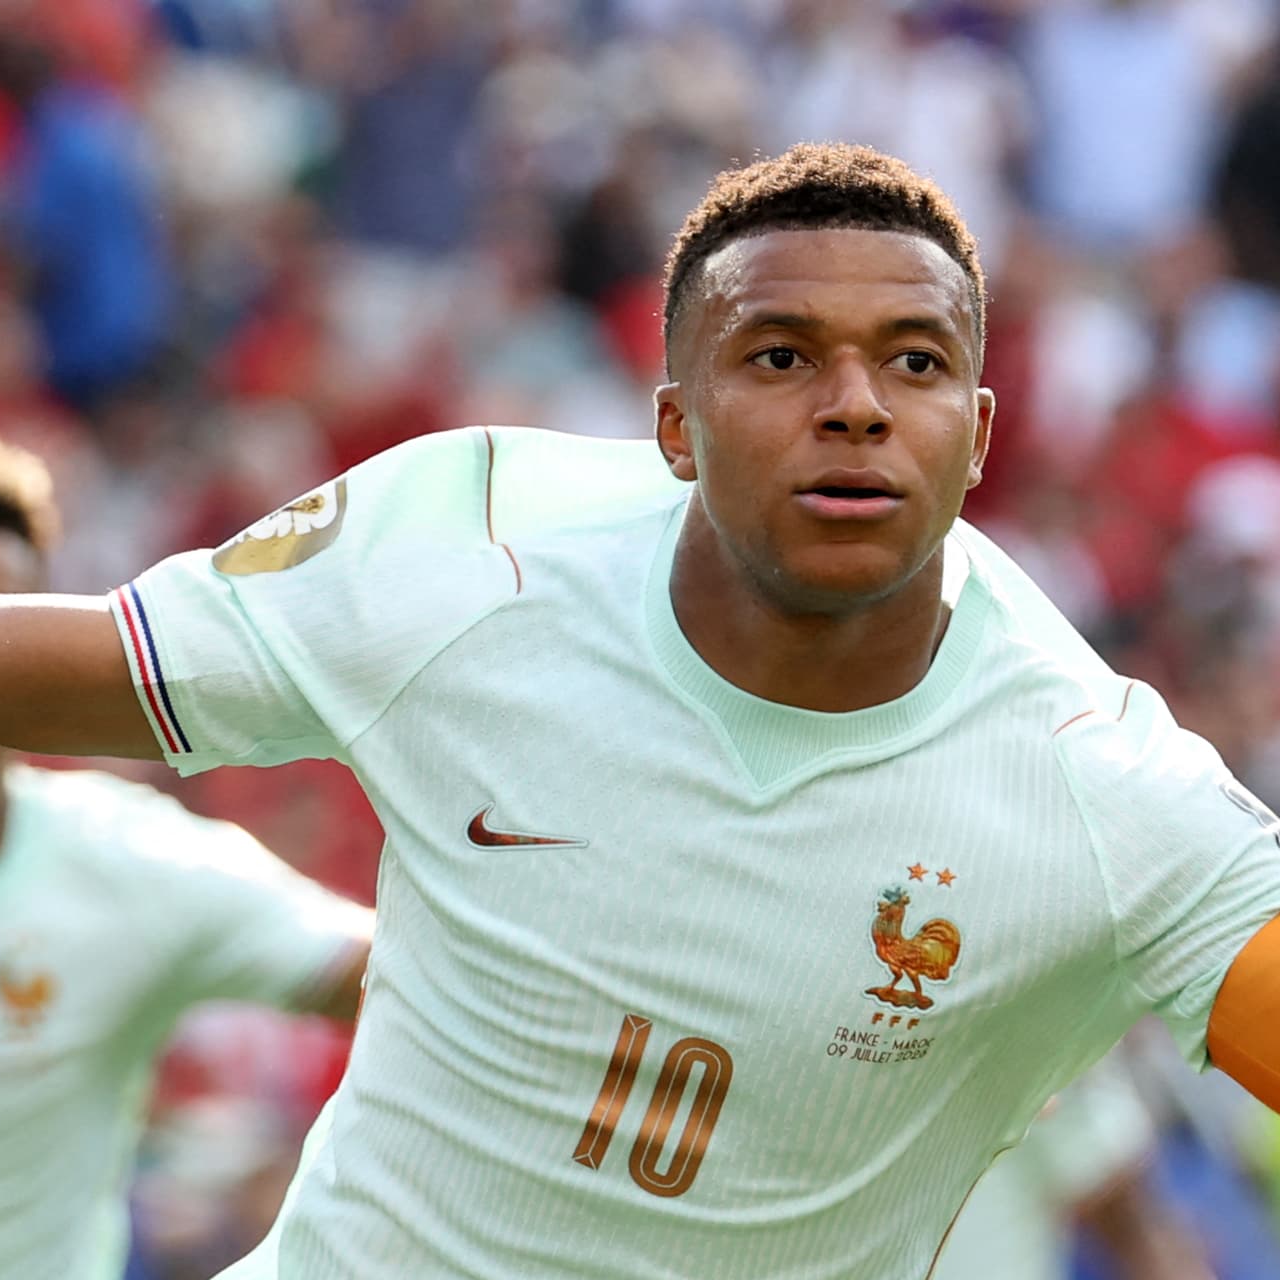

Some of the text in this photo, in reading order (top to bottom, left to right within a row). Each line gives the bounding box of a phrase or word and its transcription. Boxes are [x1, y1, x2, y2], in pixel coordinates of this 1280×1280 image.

[834, 1026, 880, 1047] FRANCE
[826, 1042, 848, 1057] 09
[850, 1047, 892, 1063] JUILLET
[572, 1013, 733, 1198] 10
